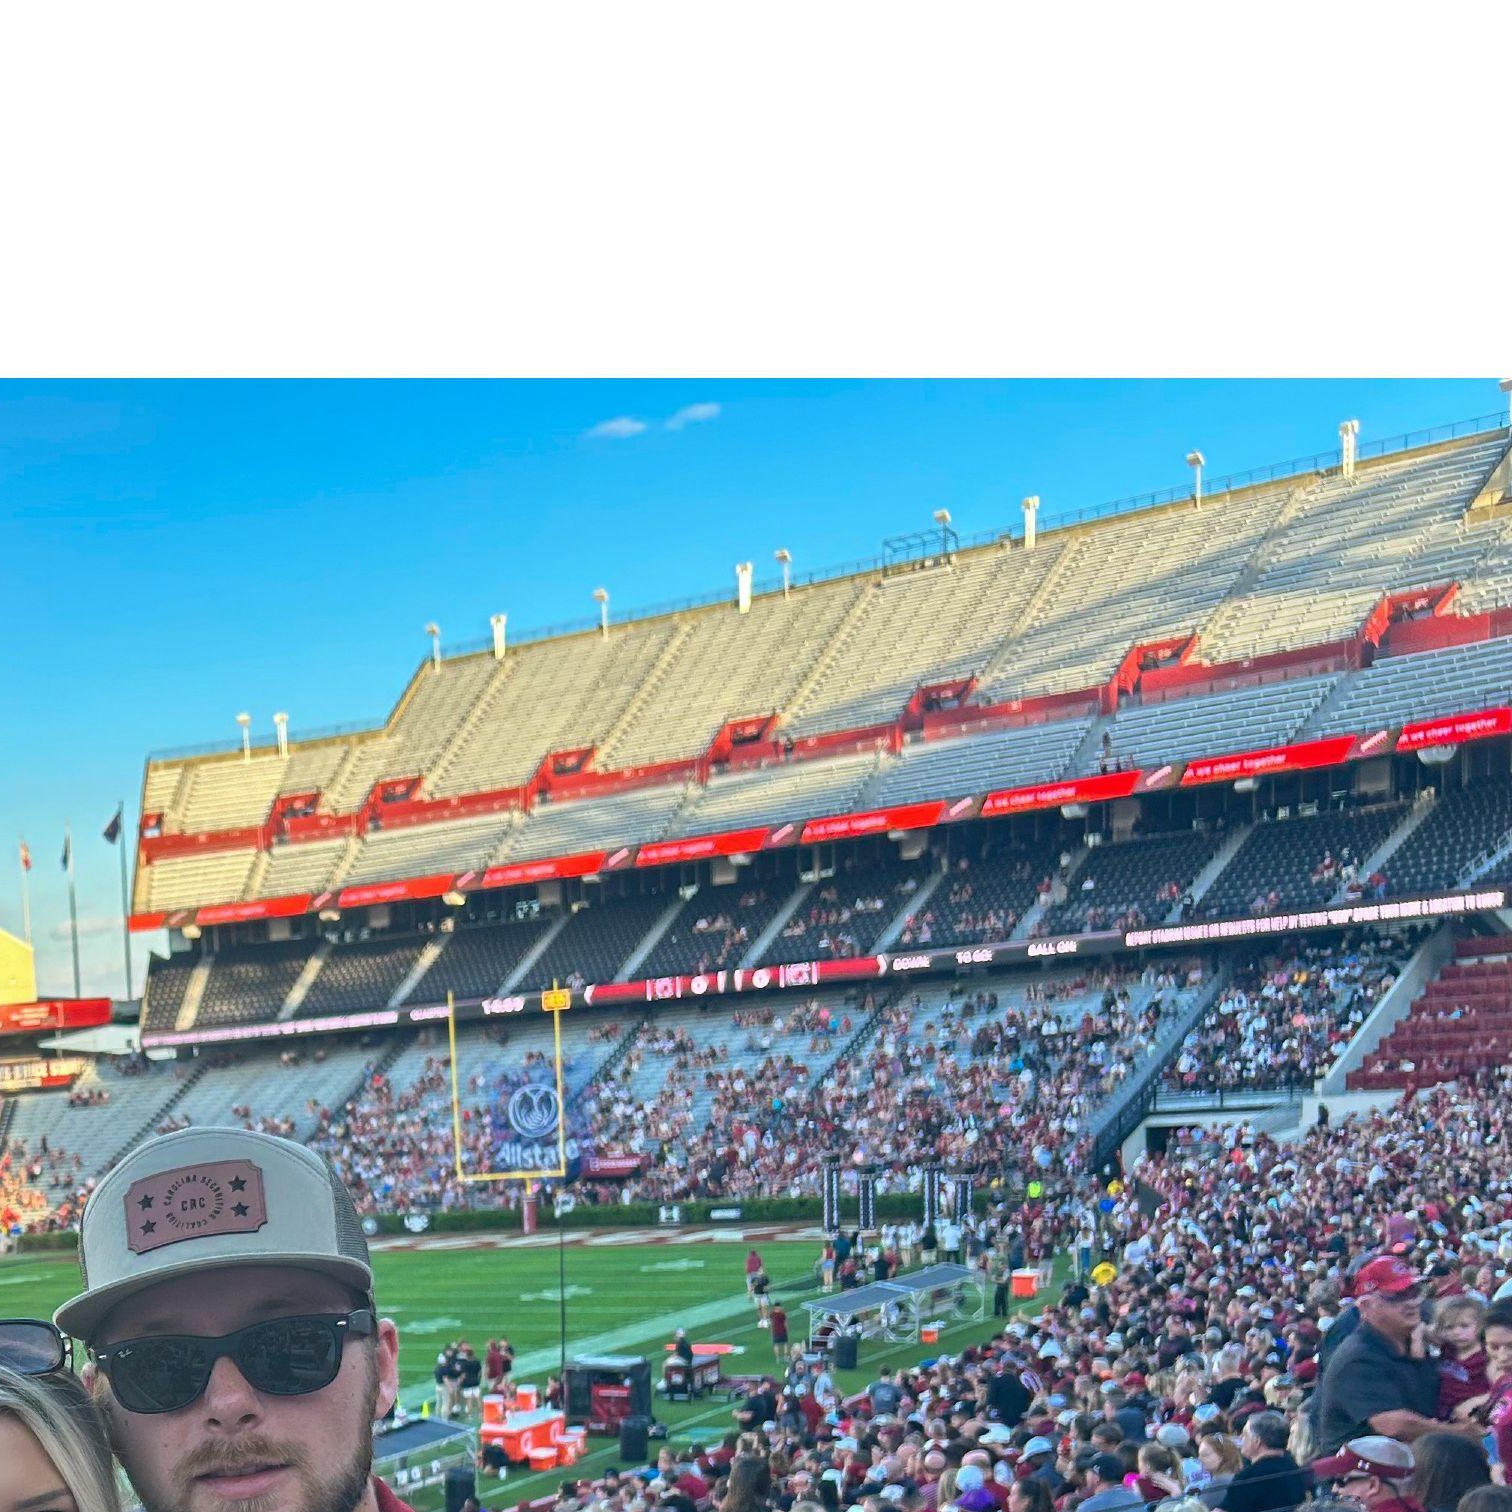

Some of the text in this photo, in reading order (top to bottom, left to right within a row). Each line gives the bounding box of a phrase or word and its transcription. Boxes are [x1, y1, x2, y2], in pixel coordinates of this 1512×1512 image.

[1427, 725, 1454, 739] cheer
[1456, 717, 1497, 736] together
[1213, 760, 1241, 775] cheer
[1243, 754, 1286, 769] together
[1256, 918, 1271, 933] FOR
[1271, 916, 1288, 931] HELP
[1028, 942, 1056, 957] BALL
[494, 1138, 579, 1168] Allstae
[181, 1197, 206, 1211] CRC
